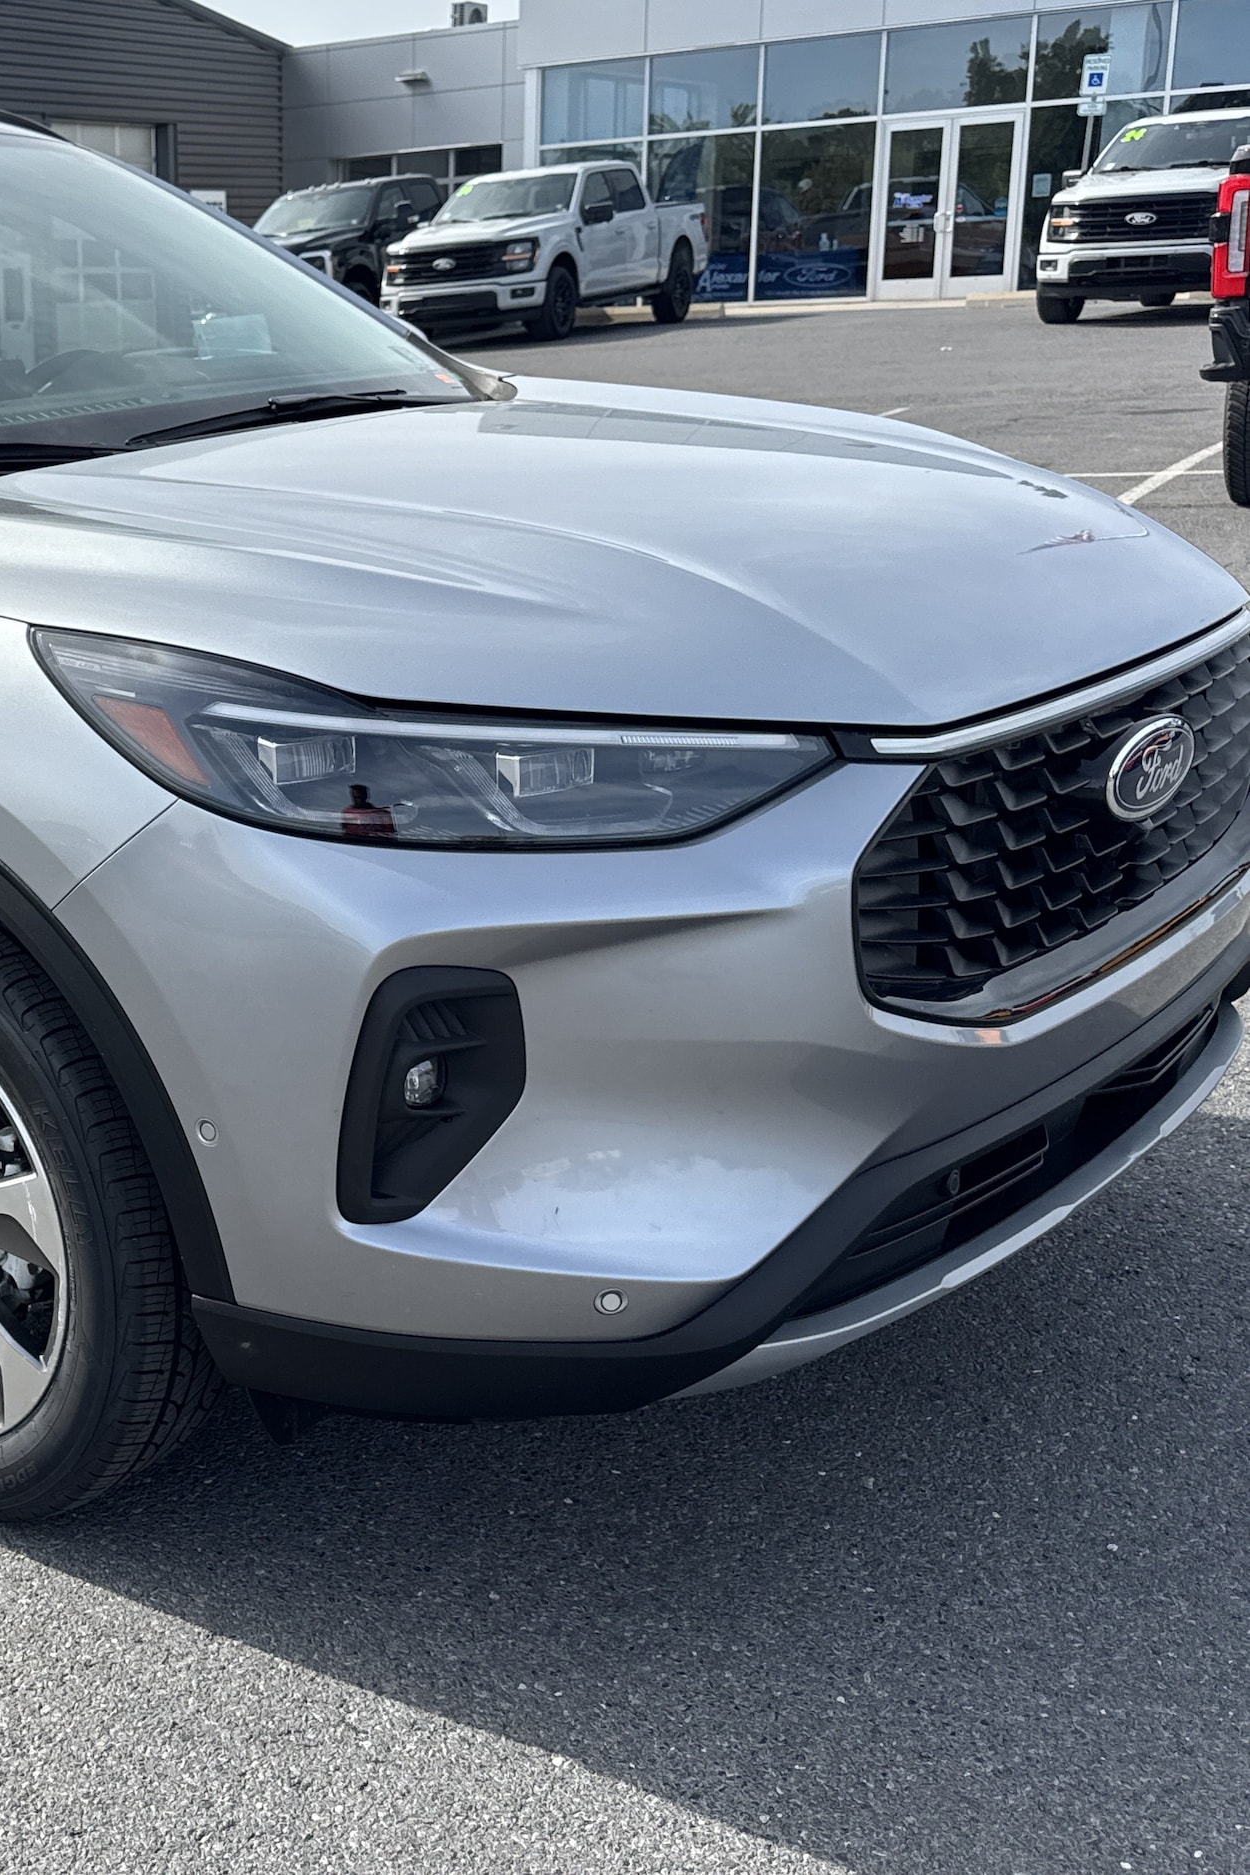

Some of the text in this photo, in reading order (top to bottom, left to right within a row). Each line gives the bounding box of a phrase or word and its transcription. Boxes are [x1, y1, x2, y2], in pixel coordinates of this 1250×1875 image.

[795, 267, 838, 283] Ford
[1135, 738, 1185, 801] Ford
[28, 1098, 104, 1246] KELLY
